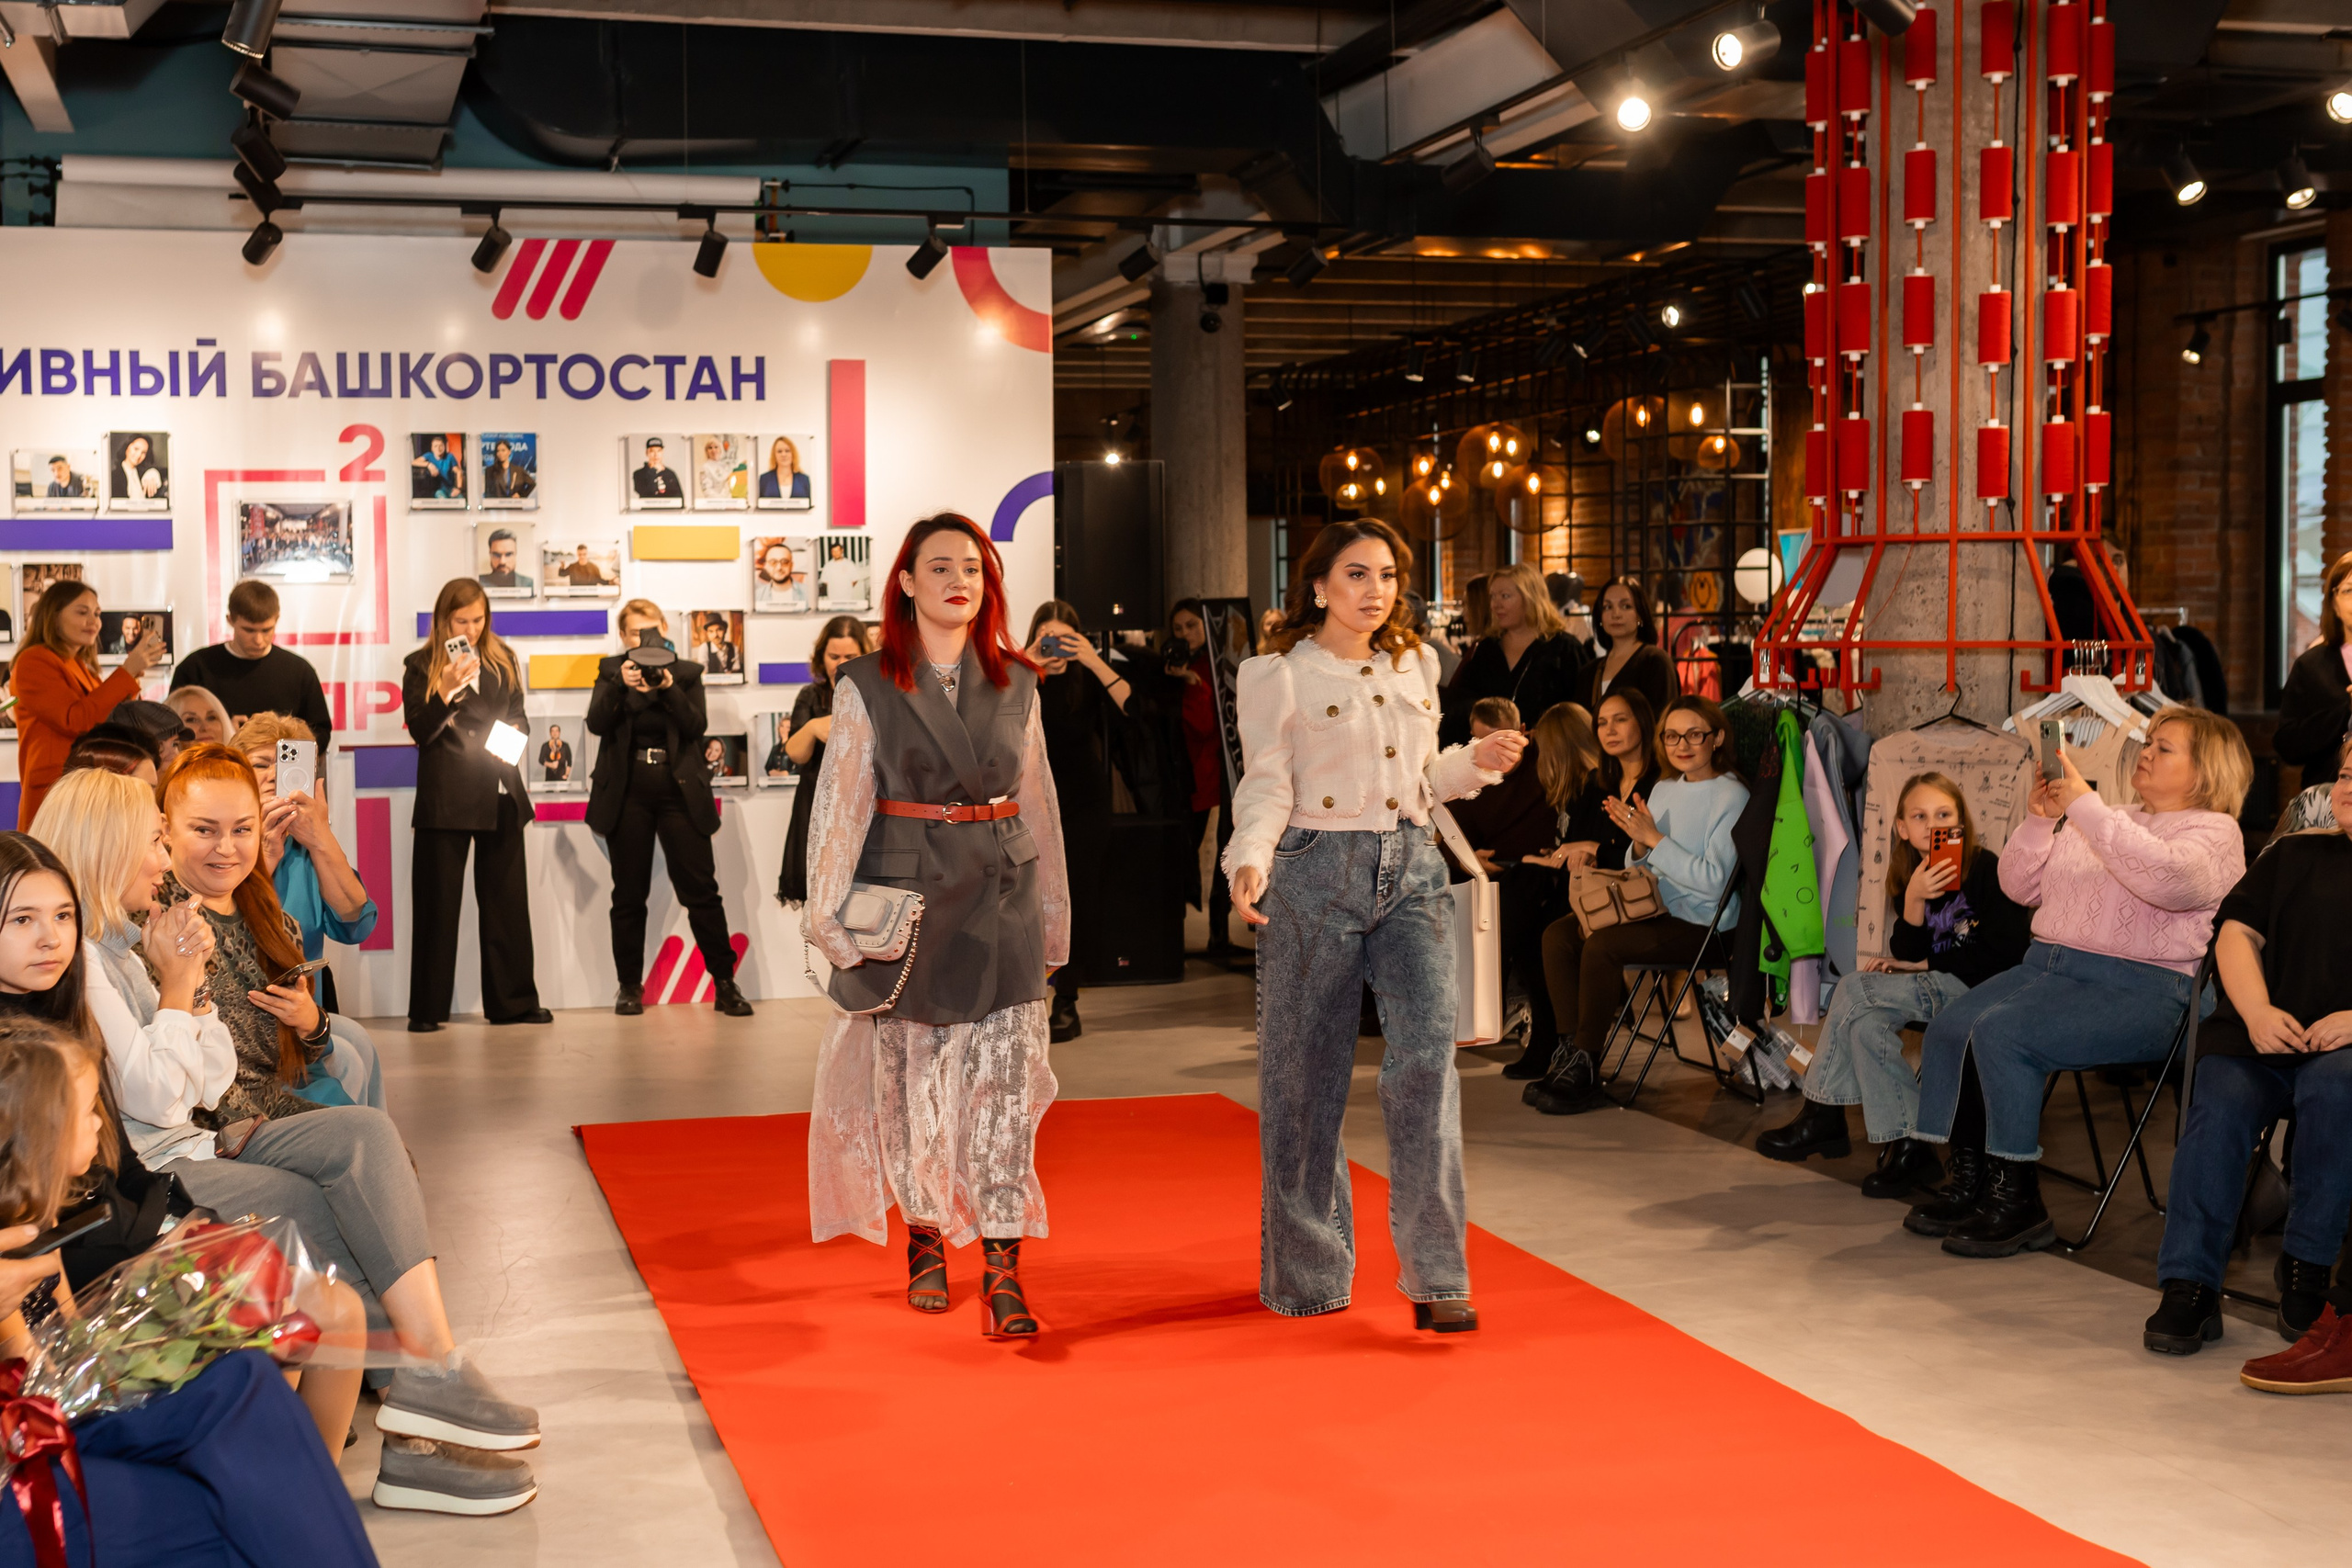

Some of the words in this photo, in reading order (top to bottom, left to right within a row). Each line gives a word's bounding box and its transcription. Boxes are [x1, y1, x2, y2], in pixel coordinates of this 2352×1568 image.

[0, 338, 227, 398] ИВНЫЙ
[252, 352, 766, 401] БАШКОРТОСТАН
[338, 423, 386, 482] 2
